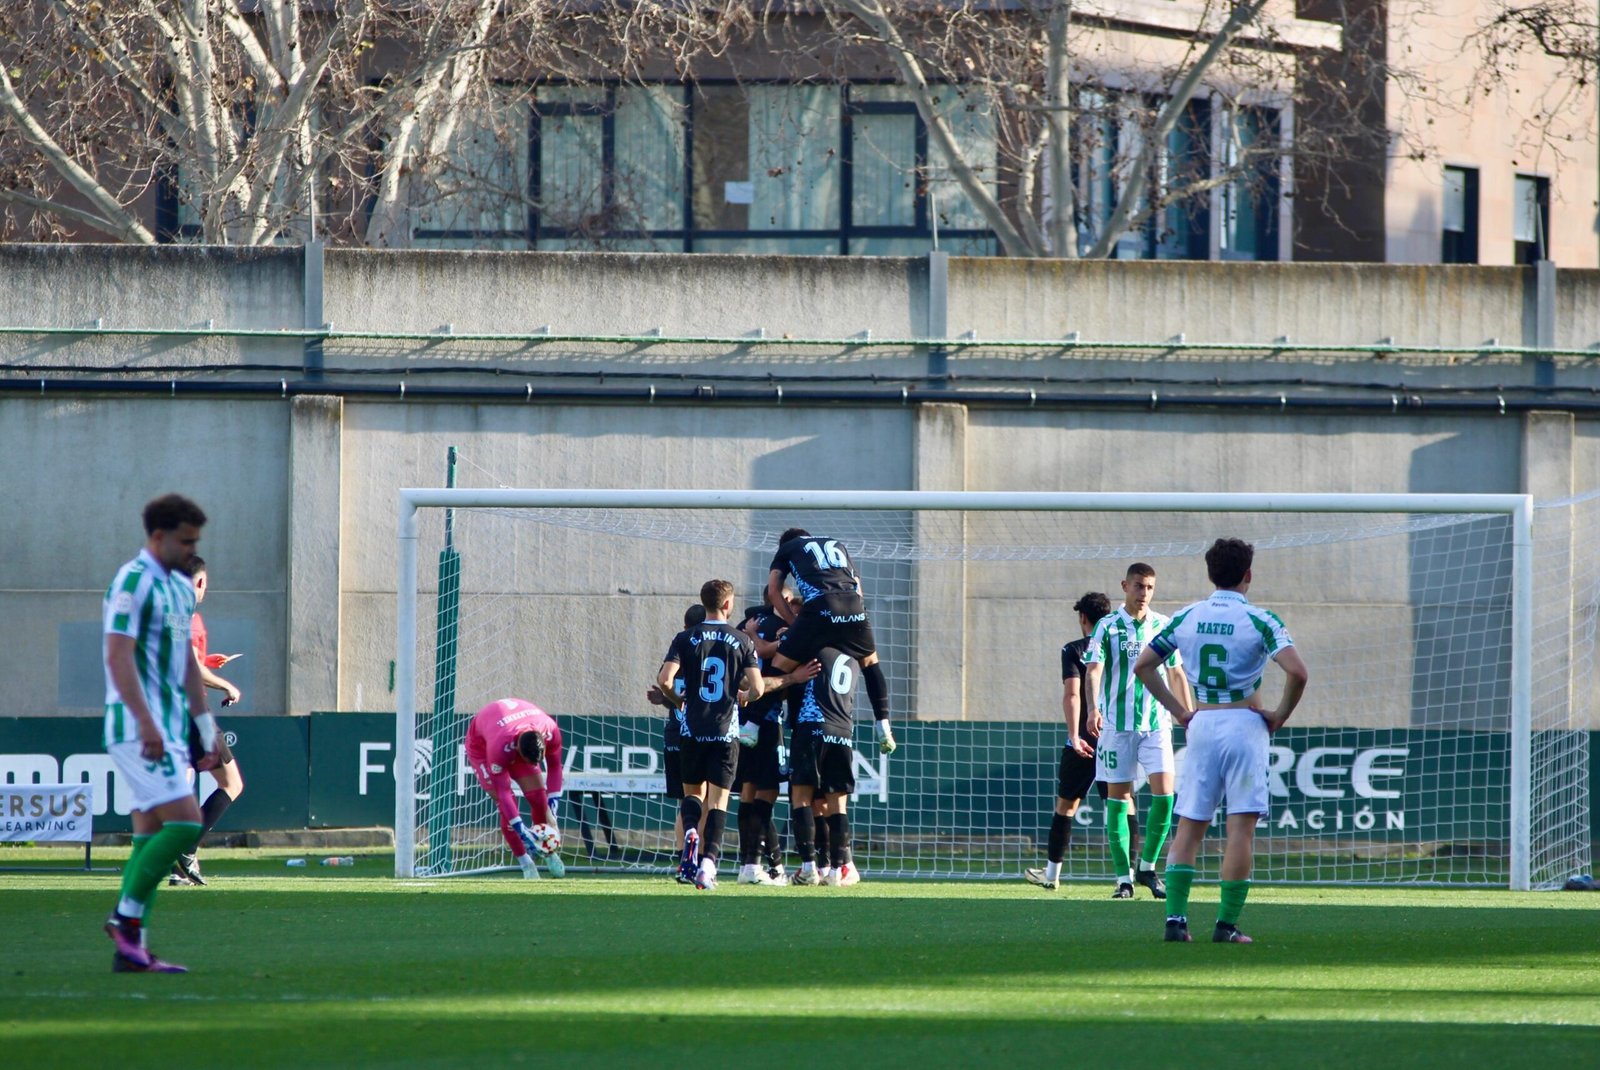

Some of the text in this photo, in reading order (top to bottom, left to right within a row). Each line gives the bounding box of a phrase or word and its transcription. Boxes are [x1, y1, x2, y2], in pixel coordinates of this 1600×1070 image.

[803, 540, 848, 570] 16
[830, 612, 866, 623] VALANS
[1197, 622, 1235, 635] MATEO
[702, 630, 741, 650] MOLINA
[830, 653, 853, 695] 6
[1198, 643, 1229, 690] 6
[698, 656, 726, 703] 3
[1103, 750, 1118, 769] 15
[0, 794, 87, 817] RSUS
